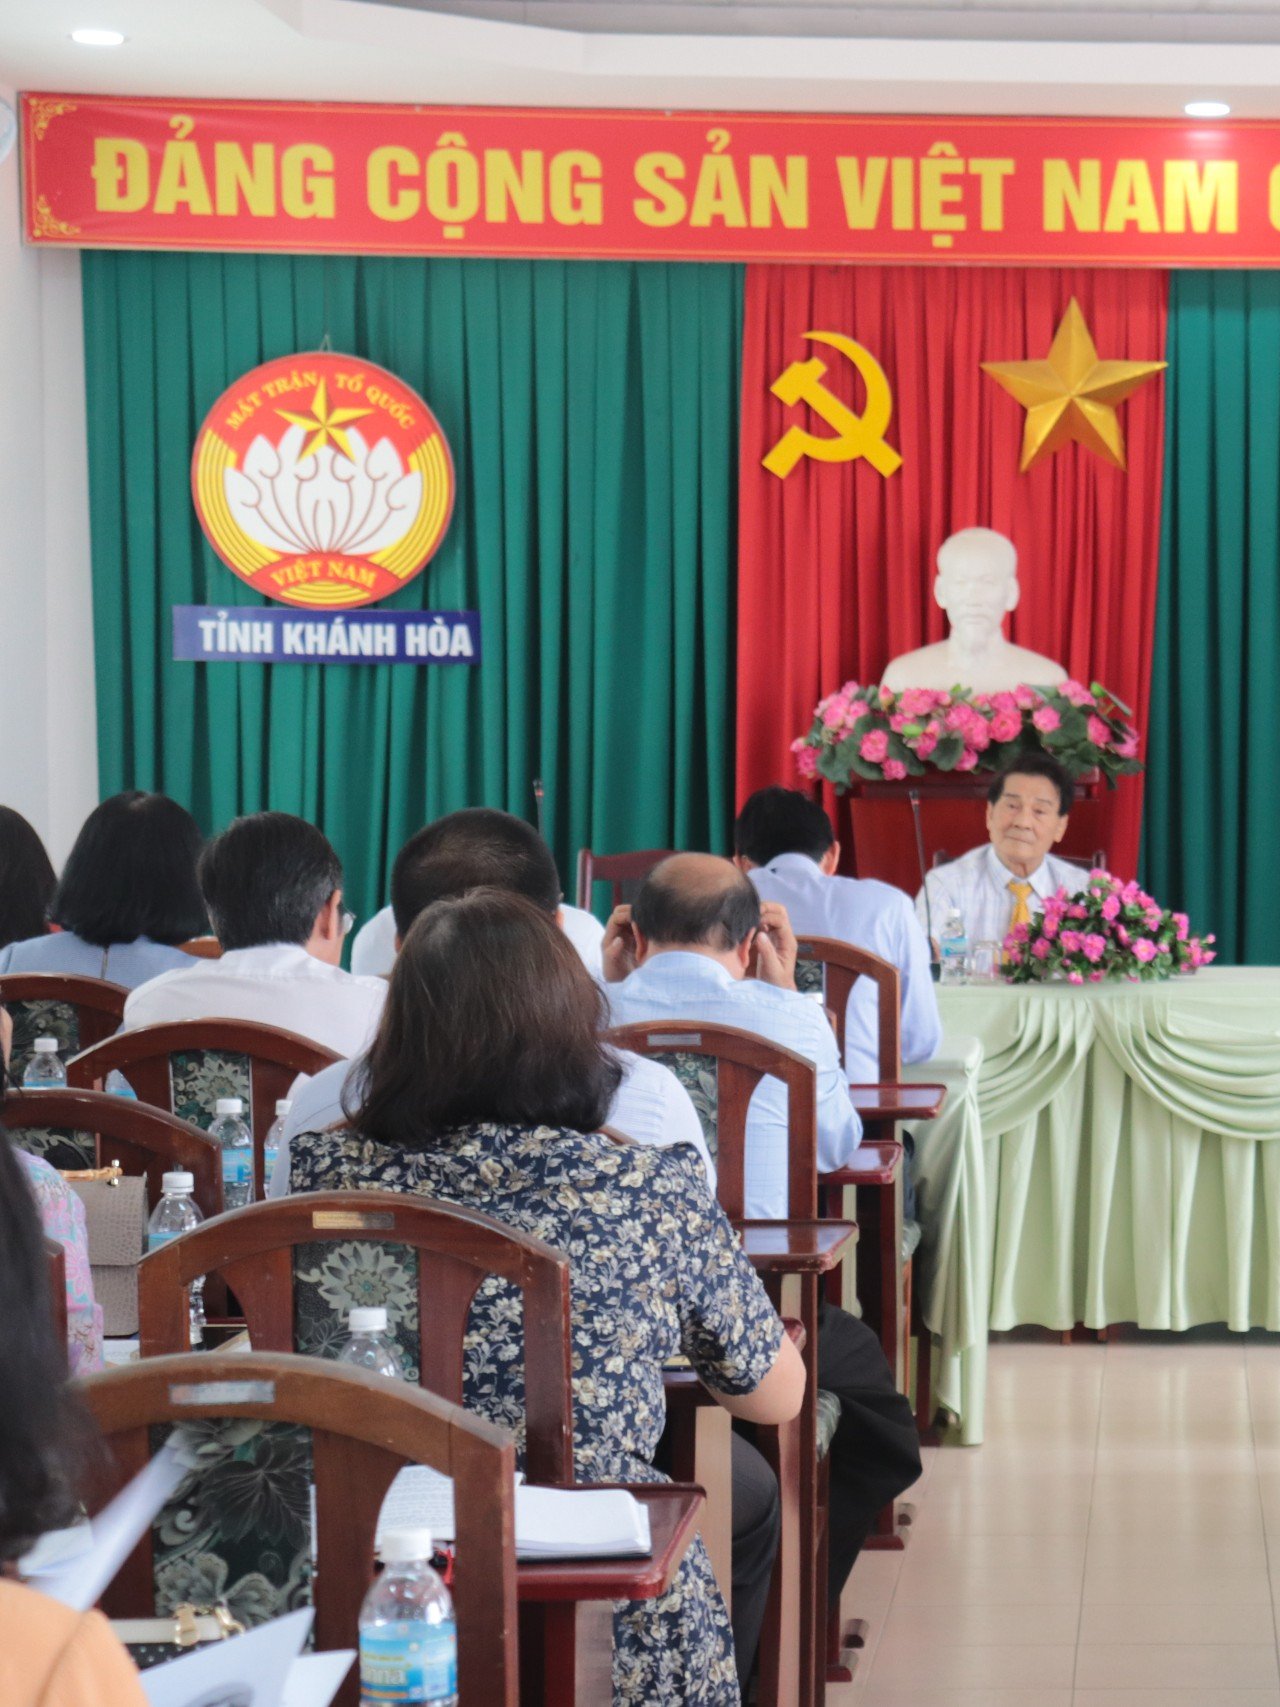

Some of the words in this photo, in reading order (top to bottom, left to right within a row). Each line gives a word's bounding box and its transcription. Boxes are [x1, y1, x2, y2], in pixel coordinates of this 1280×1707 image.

[91, 115, 336, 220] ĐẢNG
[367, 131, 603, 240] CỘNG
[633, 129, 808, 229] SẢN
[836, 141, 1015, 248] VIỆT
[1042, 158, 1239, 235] NAM
[224, 392, 263, 431] MẶT
[261, 369, 318, 399] TRẬN
[365, 384, 416, 430] QUỐC
[270, 560, 321, 588] VIỆT
[328, 561, 378, 589] NAM
[198, 611, 275, 656] TỈNH
[282, 616, 398, 657] KHÁNH
[405, 616, 474, 657] HÒA
